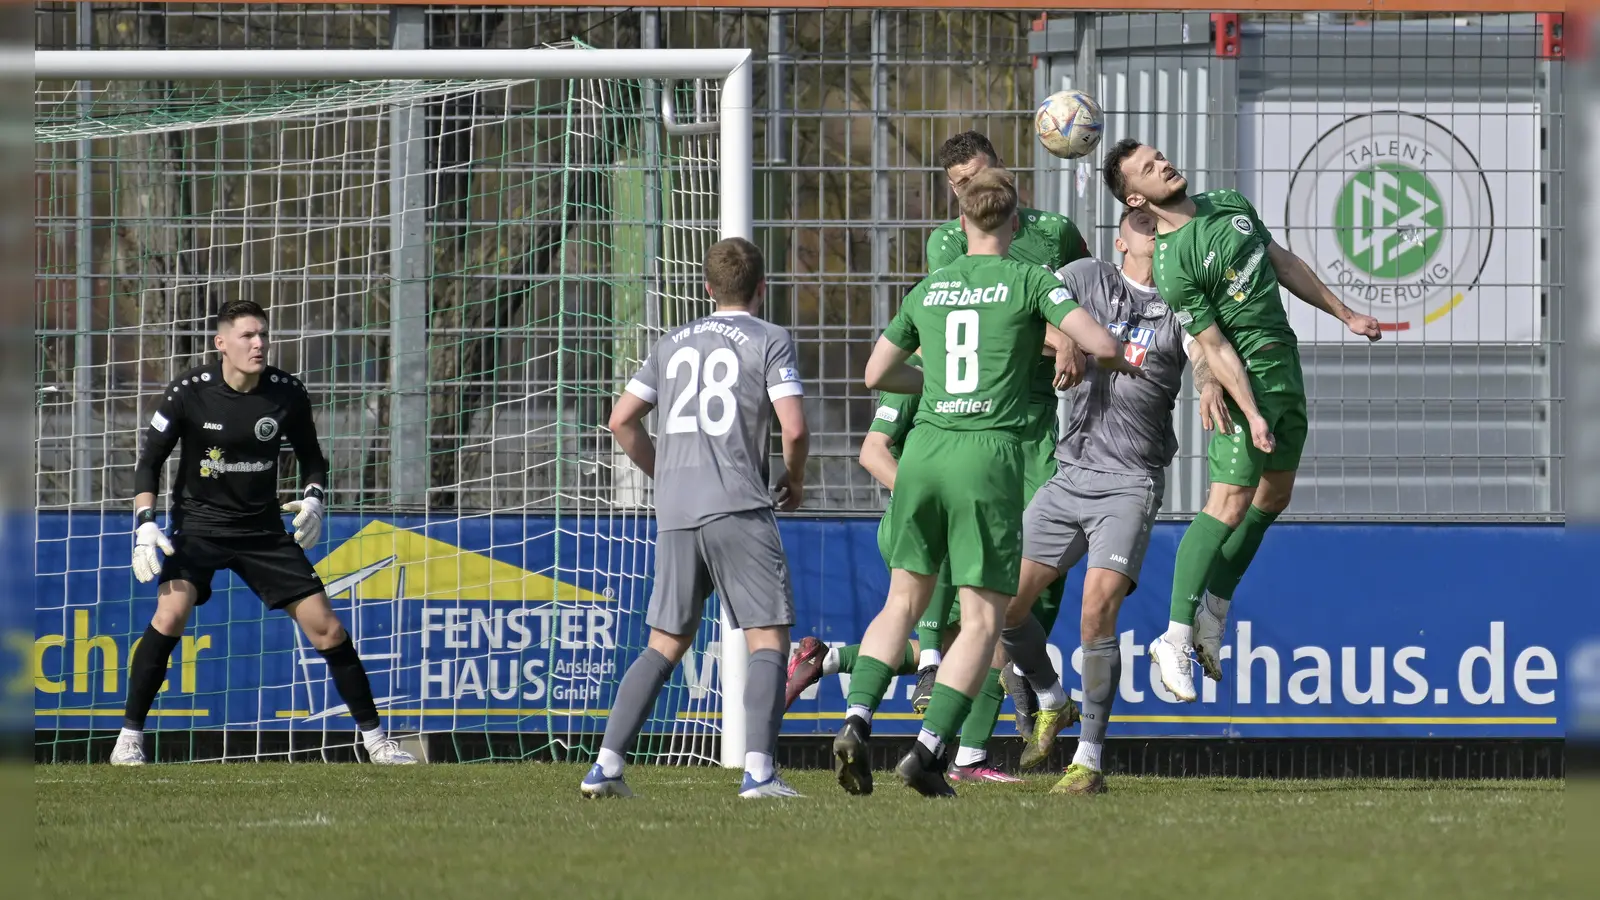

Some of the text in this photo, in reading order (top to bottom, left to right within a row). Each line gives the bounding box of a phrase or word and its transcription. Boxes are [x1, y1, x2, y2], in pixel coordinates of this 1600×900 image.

[1346, 140, 1433, 165] TALENT
[1203, 250, 1216, 269] JAKO
[1327, 258, 1449, 304] FÖRDERUNG
[922, 282, 1008, 307] ansbach
[945, 309, 979, 394] 8
[665, 346, 739, 437] 28
[934, 398, 993, 414] seefried
[202, 421, 223, 431] JAKO
[1109, 553, 1129, 565] JAKO
[421, 607, 615, 650] FENSTER
[918, 620, 938, 628] JAKO
[554, 658, 616, 675] Ansbach
[421, 658, 545, 701] HAUS
[552, 684, 600, 700] GmbH
